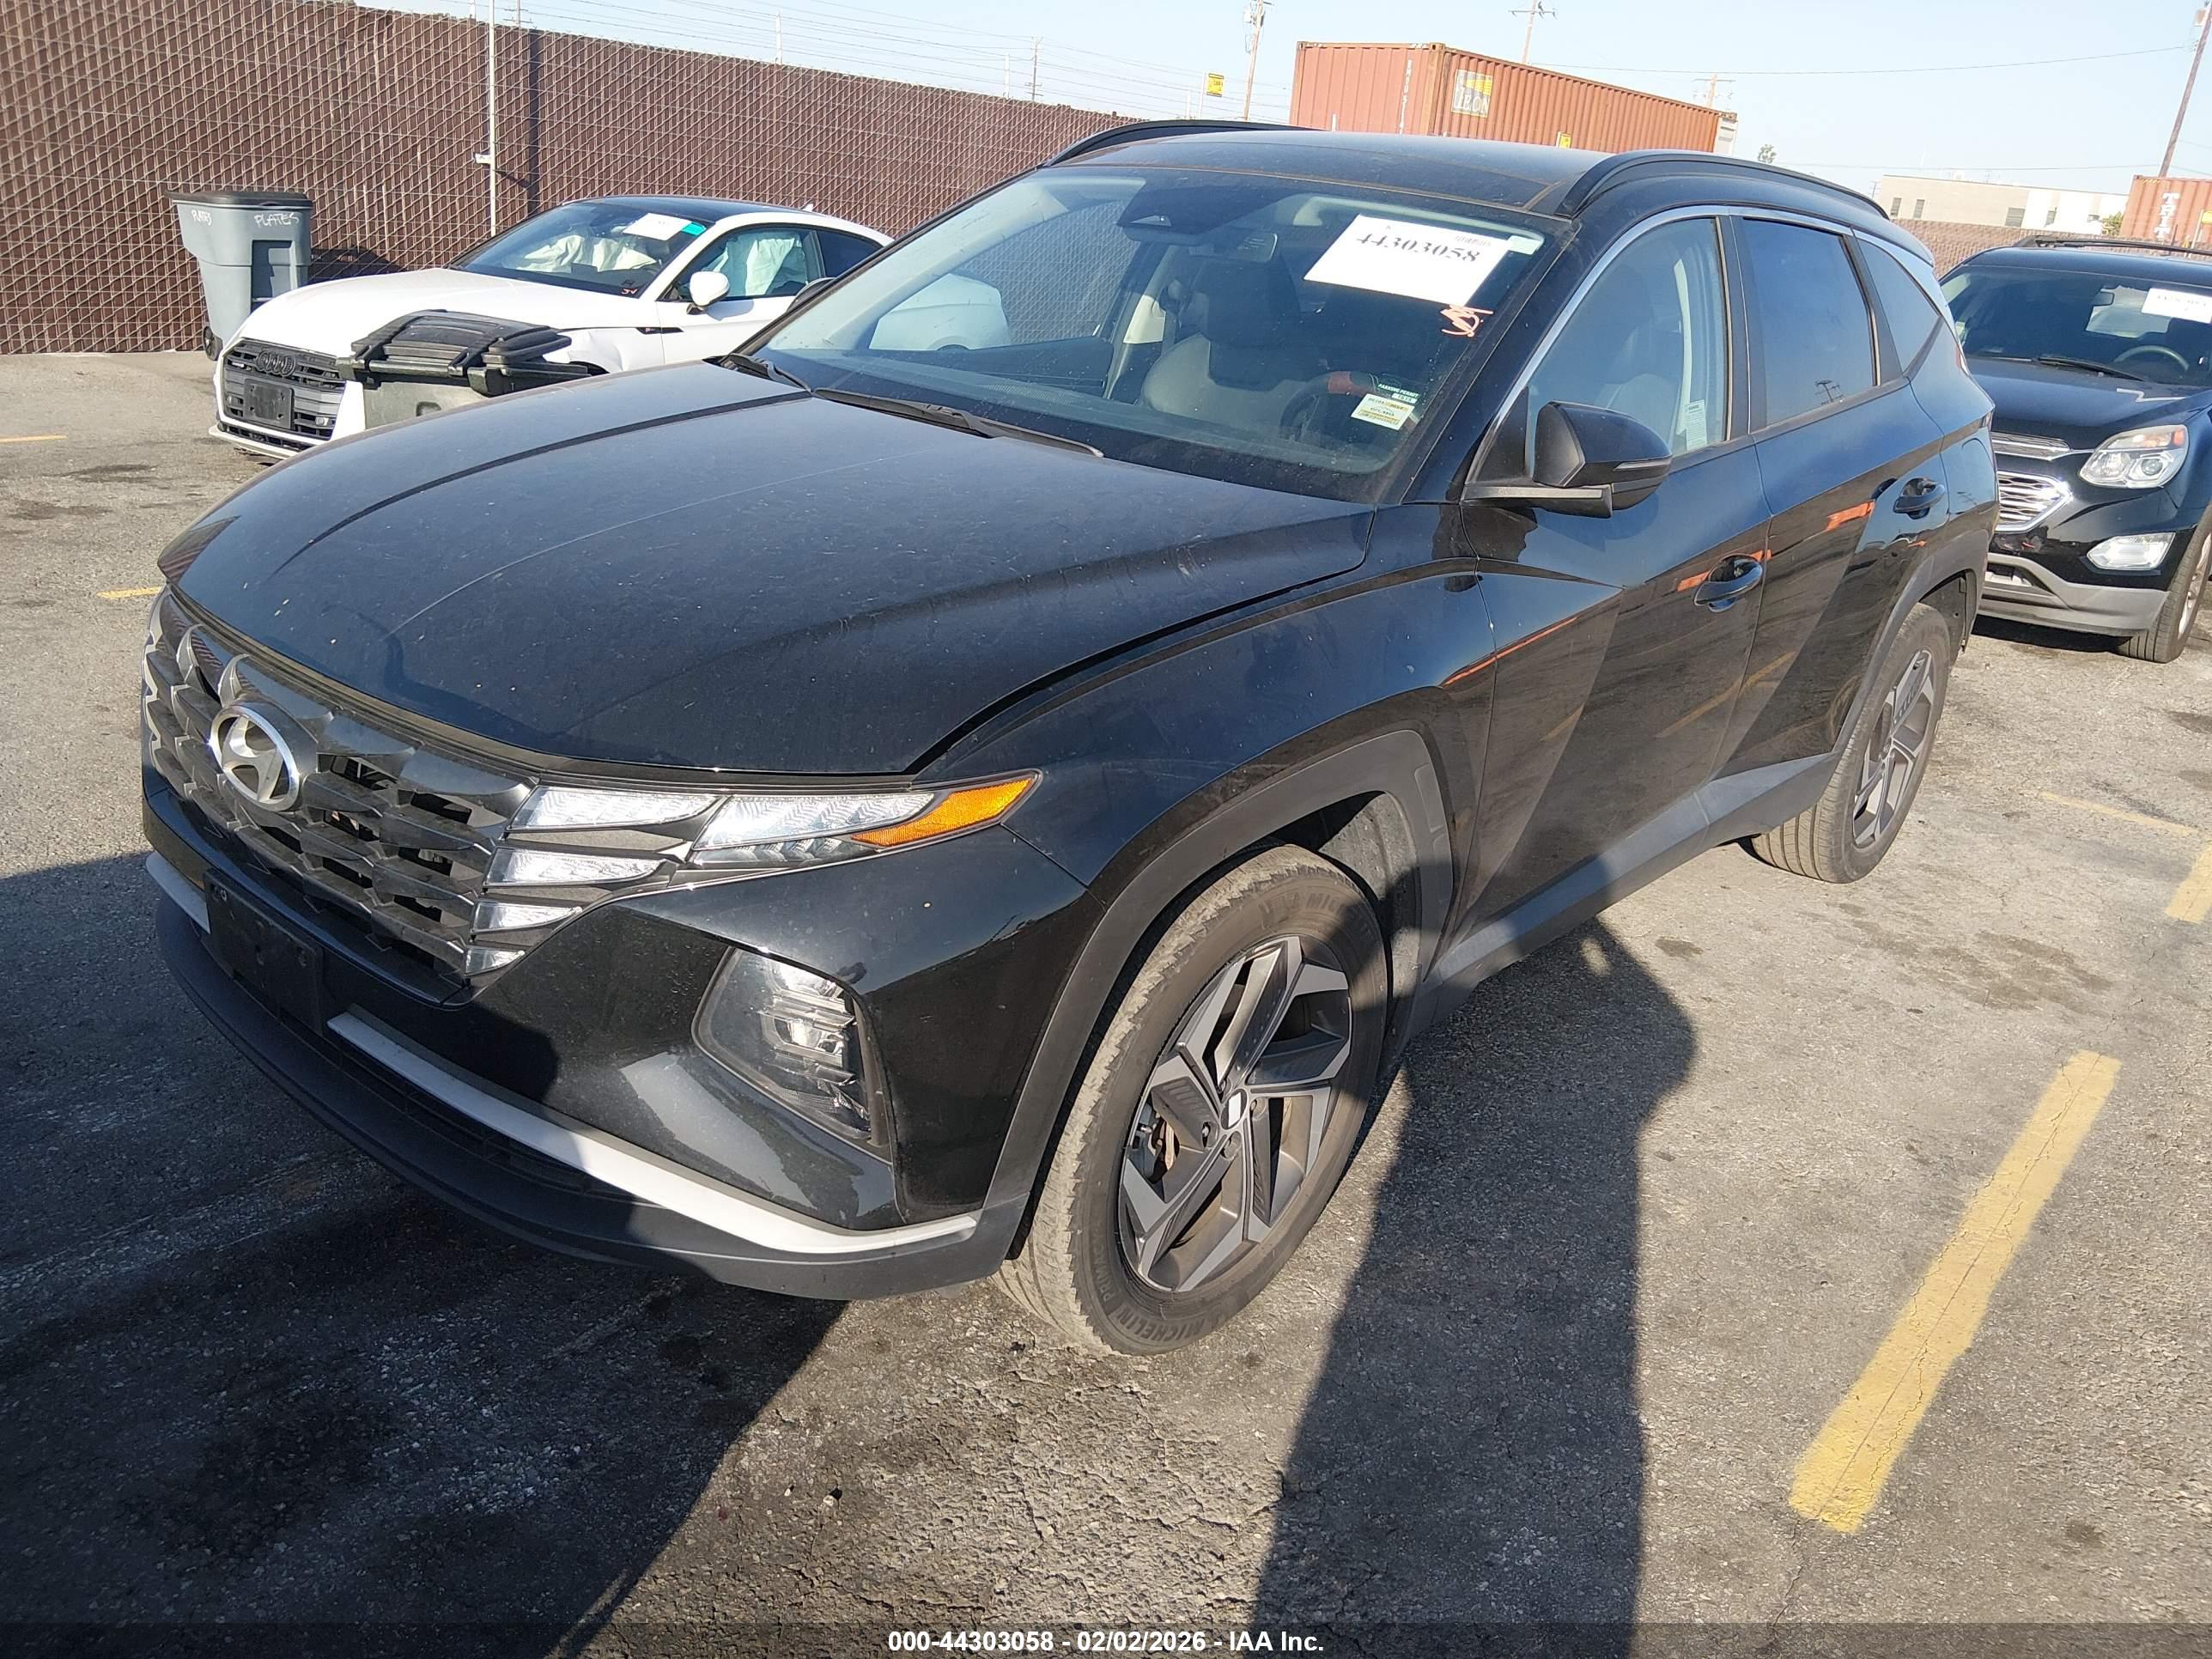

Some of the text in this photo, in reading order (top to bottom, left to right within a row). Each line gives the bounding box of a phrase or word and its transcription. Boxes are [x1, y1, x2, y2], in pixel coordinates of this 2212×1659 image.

[254, 212, 300, 228] PLATES
[1357, 233, 1481, 262] 44303058
[1116, 1307, 1205, 1341] MICHELIN
